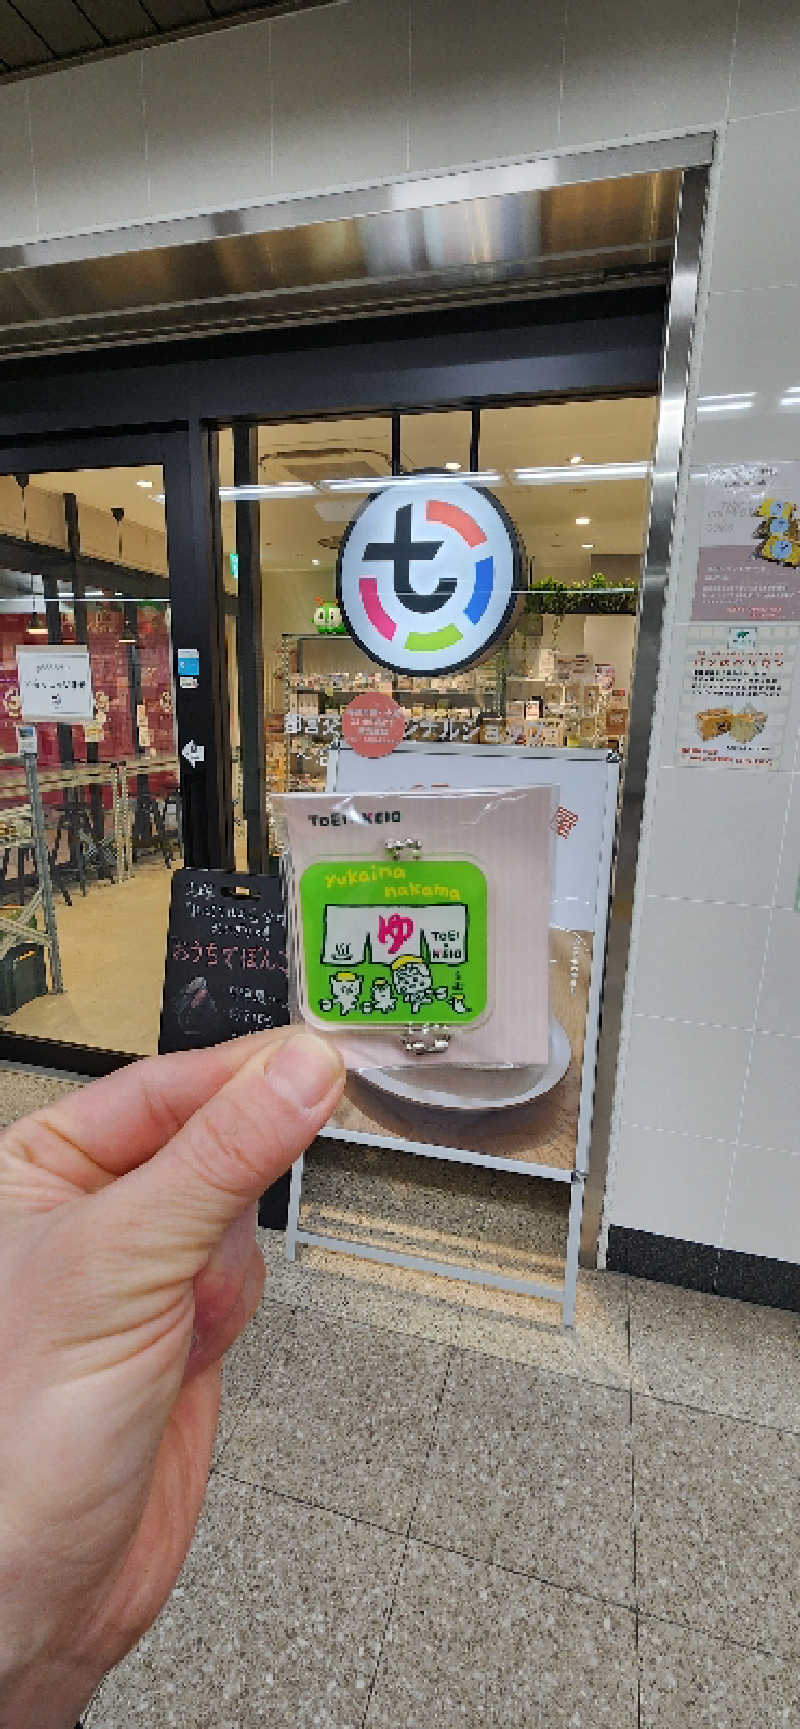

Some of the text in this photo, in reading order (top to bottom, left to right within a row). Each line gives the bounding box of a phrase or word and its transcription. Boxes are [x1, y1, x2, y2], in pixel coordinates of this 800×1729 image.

[325, 865, 406, 888] yukaina
[384, 882, 460, 901] nakama
[377, 912, 416, 955] ゆ
[432, 949, 462, 959] KEIO
